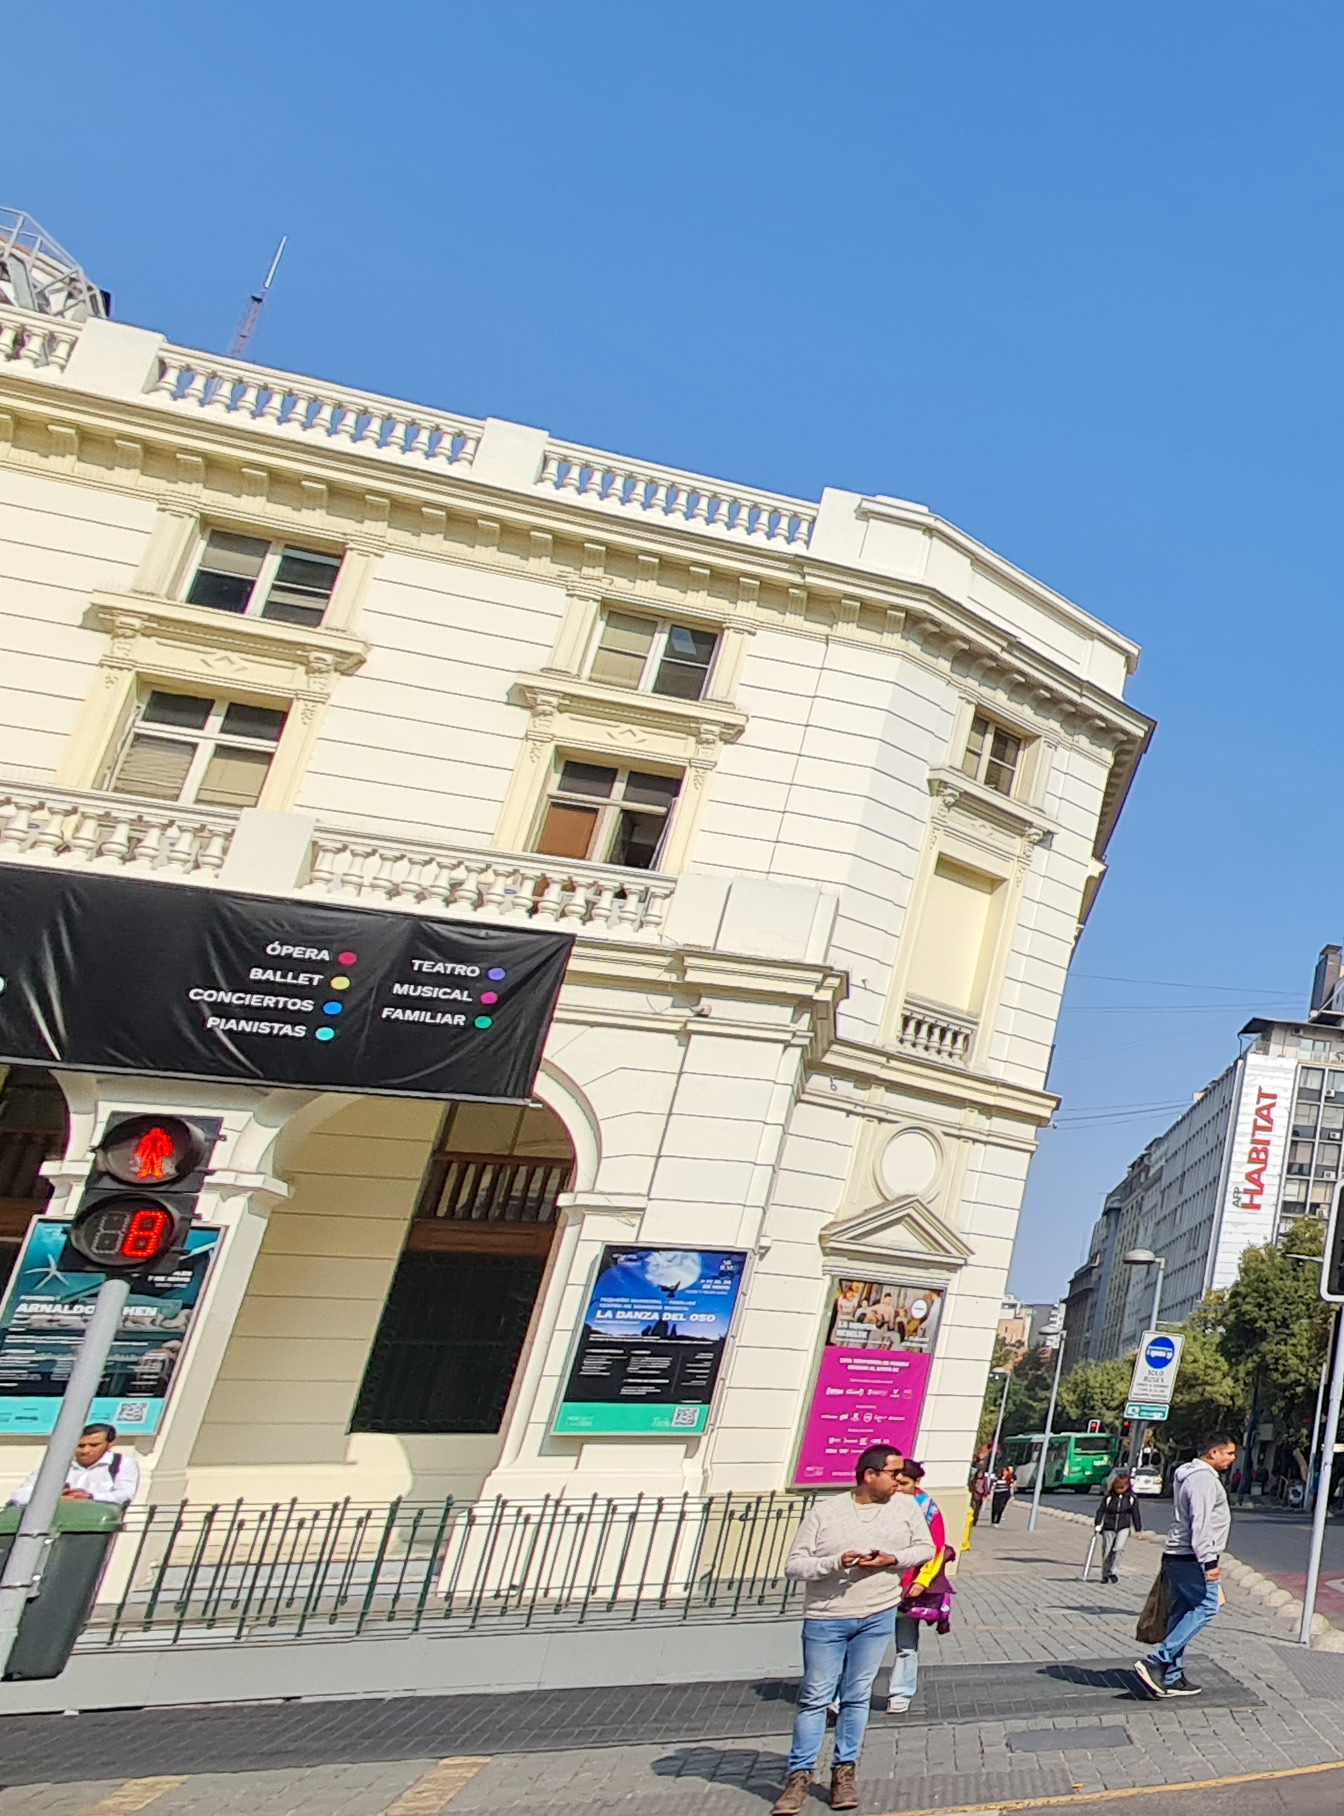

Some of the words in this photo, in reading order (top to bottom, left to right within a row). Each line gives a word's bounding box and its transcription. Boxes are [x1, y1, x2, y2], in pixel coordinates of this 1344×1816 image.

[266, 940, 330, 961] ÓPERA
[249, 967, 324, 986] BALLET
[411, 959, 480, 977] TEATRO
[188, 988, 315, 1012] CONCIERTOS
[392, 983, 473, 1002] MUSICAL
[381, 1007, 466, 1026] FAMILIAR
[206, 1016, 307, 1038] PIANISTAS
[1241, 1085, 1278, 1210] HABITAT
[1232, 1186, 1242, 1208] AFP
[596, 1310, 613, 1319] LA
[616, 1311, 659, 1320] DANZA
[662, 1313, 687, 1321] DEL
[689, 1313, 716, 1323] OSO
